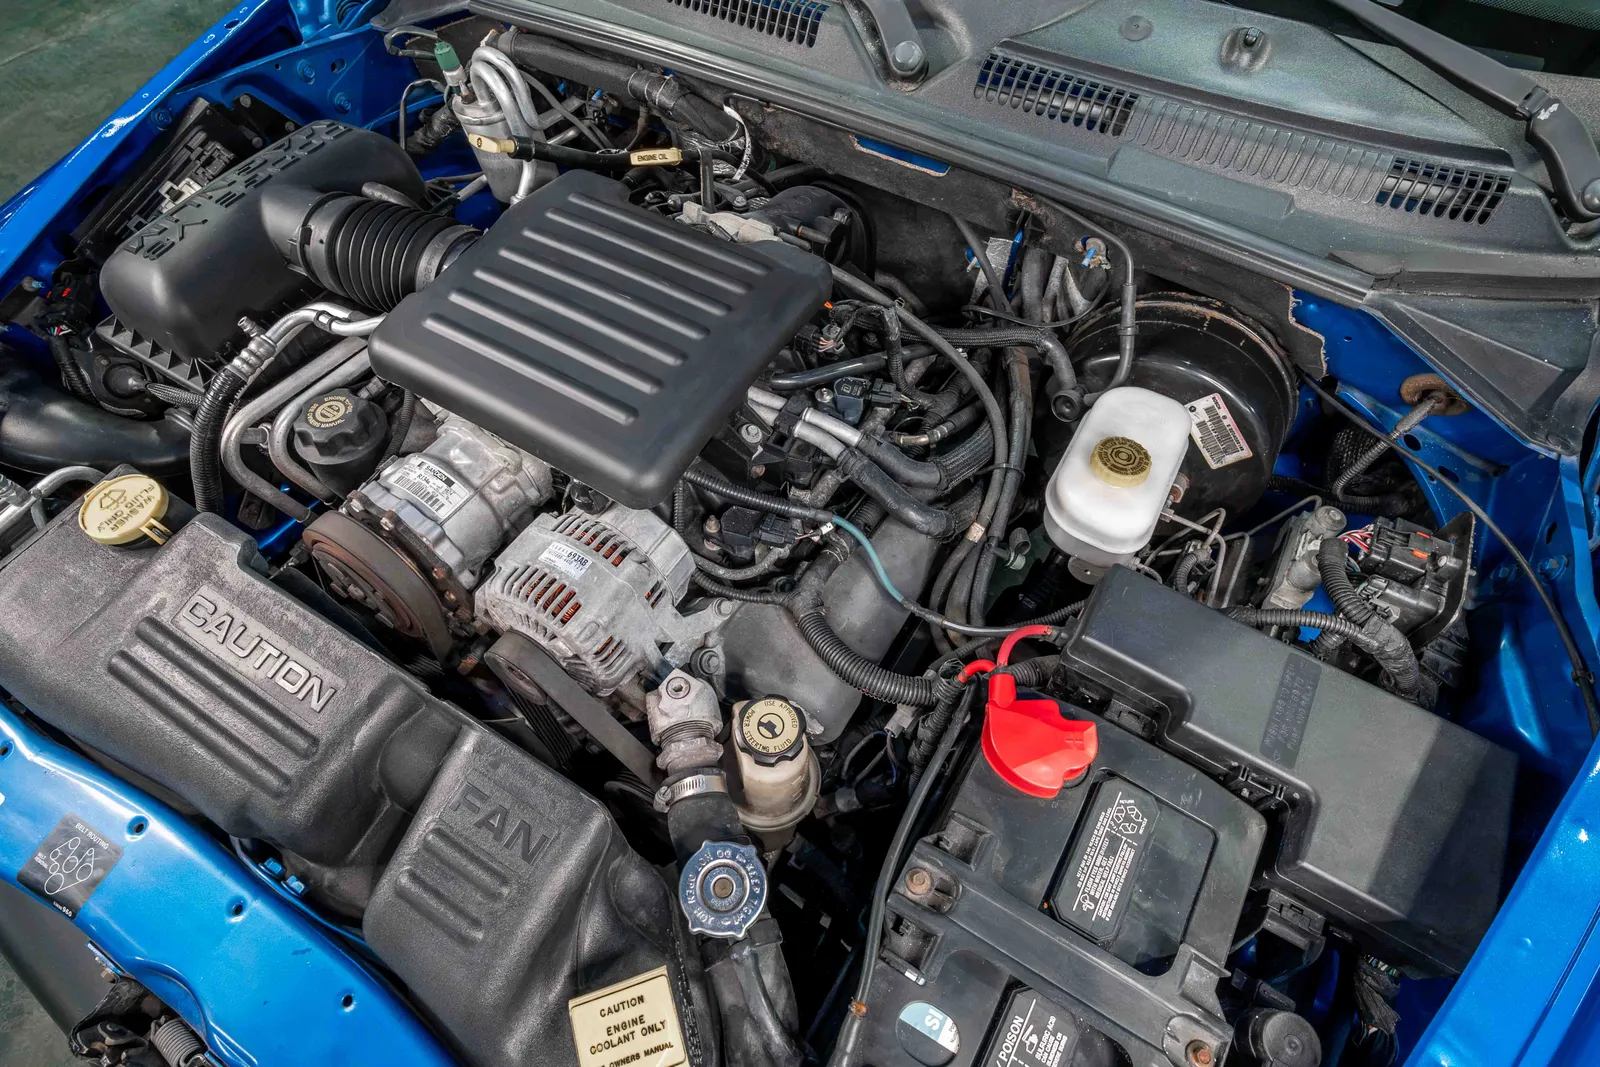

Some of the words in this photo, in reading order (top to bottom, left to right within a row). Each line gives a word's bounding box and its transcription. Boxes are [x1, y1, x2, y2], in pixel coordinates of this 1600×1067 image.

[637, 154, 657, 162] ENGINE
[143, 218, 208, 261] V8
[321, 419, 345, 428] MANUAL
[424, 465, 448, 481] SANDEN
[124, 484, 155, 509] FLUID
[97, 510, 124, 533] ONLY
[110, 494, 156, 532] WASHER
[567, 551, 589, 566] 693AB
[182, 595, 337, 713] CAUTION
[743, 709, 756, 728] POWER
[779, 703, 798, 729] APPROVED
[744, 730, 770, 752] STEERING
[773, 738, 792, 751] FLUID
[75, 822, 89, 834] BELT
[86, 831, 110, 850] ROUTING
[449, 782, 549, 866] FAN
[686, 873, 697, 904] OPEN
[746, 863, 760, 894] KEEP
[1085, 878, 1094, 893] FLUSH
[1095, 879, 1105, 899] MEDICAL
[599, 994, 645, 1018] CAUTION
[606, 1014, 646, 1036] ENGINE
[589, 1031, 636, 1055] COOLANT
[640, 1020, 667, 1037] ONLY
[998, 1015, 1025, 1062] POISON
[1035, 1030, 1051, 1060] SULFURIC
[1046, 1015, 1056, 1032] ACID
[1045, 1035, 1055, 1053] CAUSE
[609, 1053, 641, 1067] OWNERS
[644, 1041, 674, 1057] MANUAL
